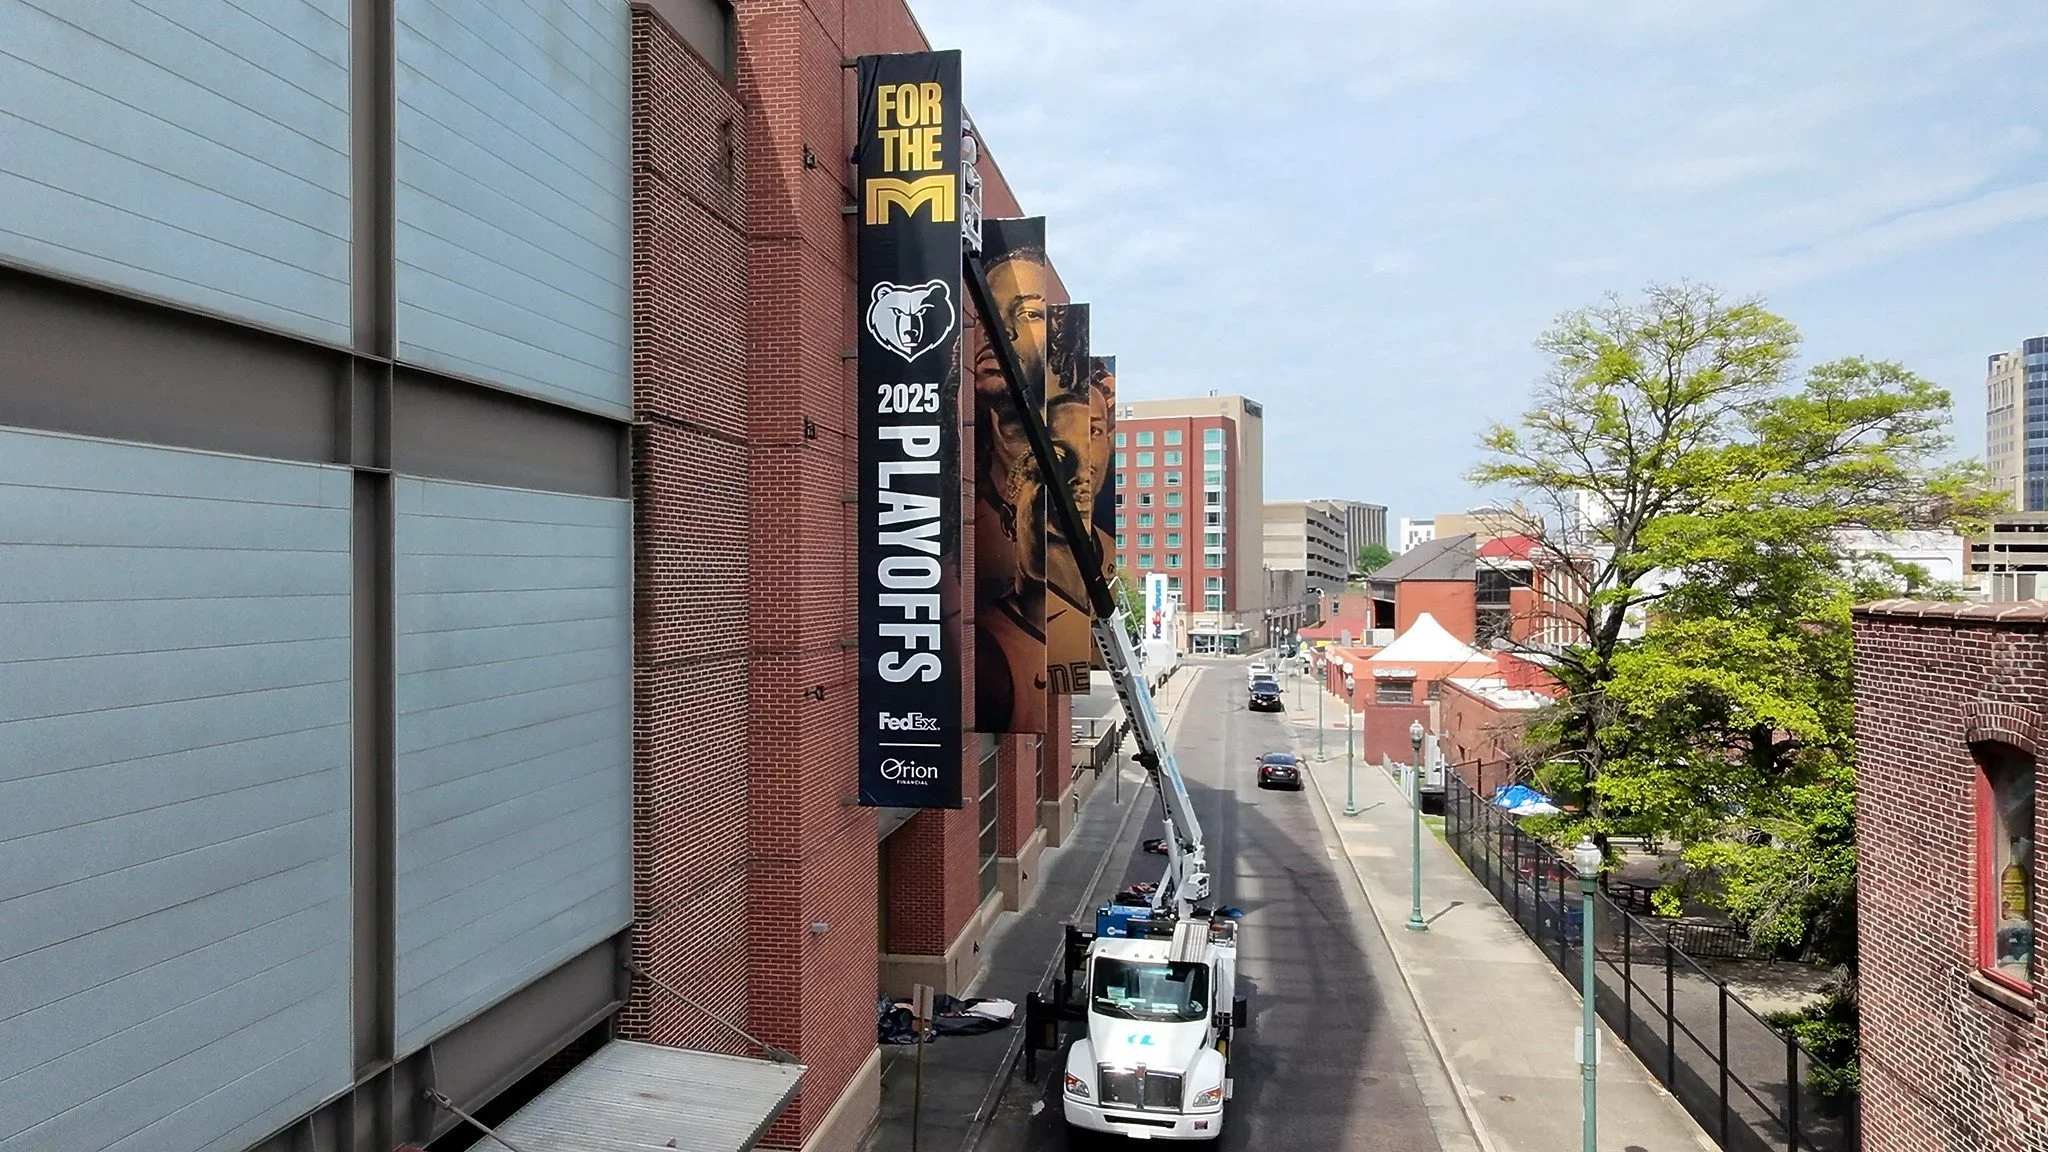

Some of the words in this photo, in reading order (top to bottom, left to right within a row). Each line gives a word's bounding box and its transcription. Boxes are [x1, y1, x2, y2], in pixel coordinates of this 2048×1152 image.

[878, 82, 942, 128] FOR
[878, 127, 943, 172] THE
[878, 383, 940, 414] 2025
[877, 425, 942, 683] PLAYOFFS
[880, 758, 938, 780] Orion
